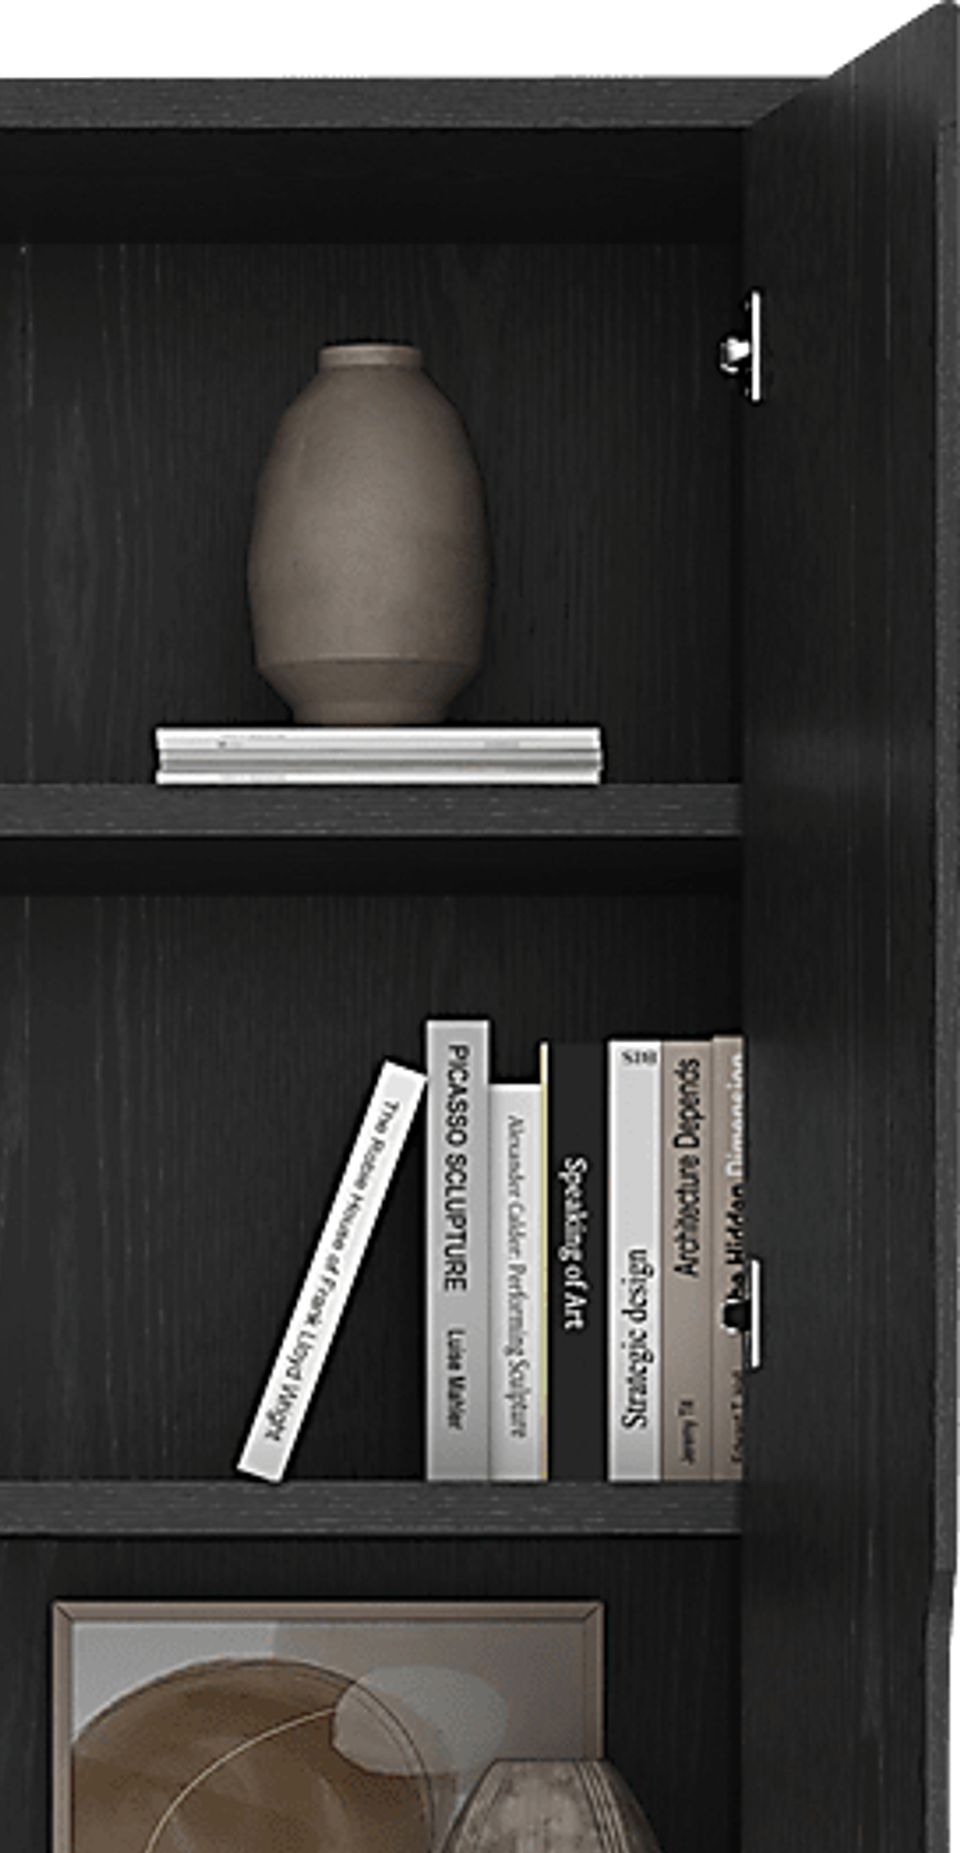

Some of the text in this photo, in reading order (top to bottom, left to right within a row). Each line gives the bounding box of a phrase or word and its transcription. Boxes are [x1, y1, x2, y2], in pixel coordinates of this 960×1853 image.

[444, 1044, 470, 1291] PICASSO SCLUPTURE
[558, 1157, 588, 1330] Speaking of Art
[673, 1057, 706, 1279] Architecture Depends
[326, 1252, 341, 1275] of
[621, 1249, 655, 1429] Strategic design
